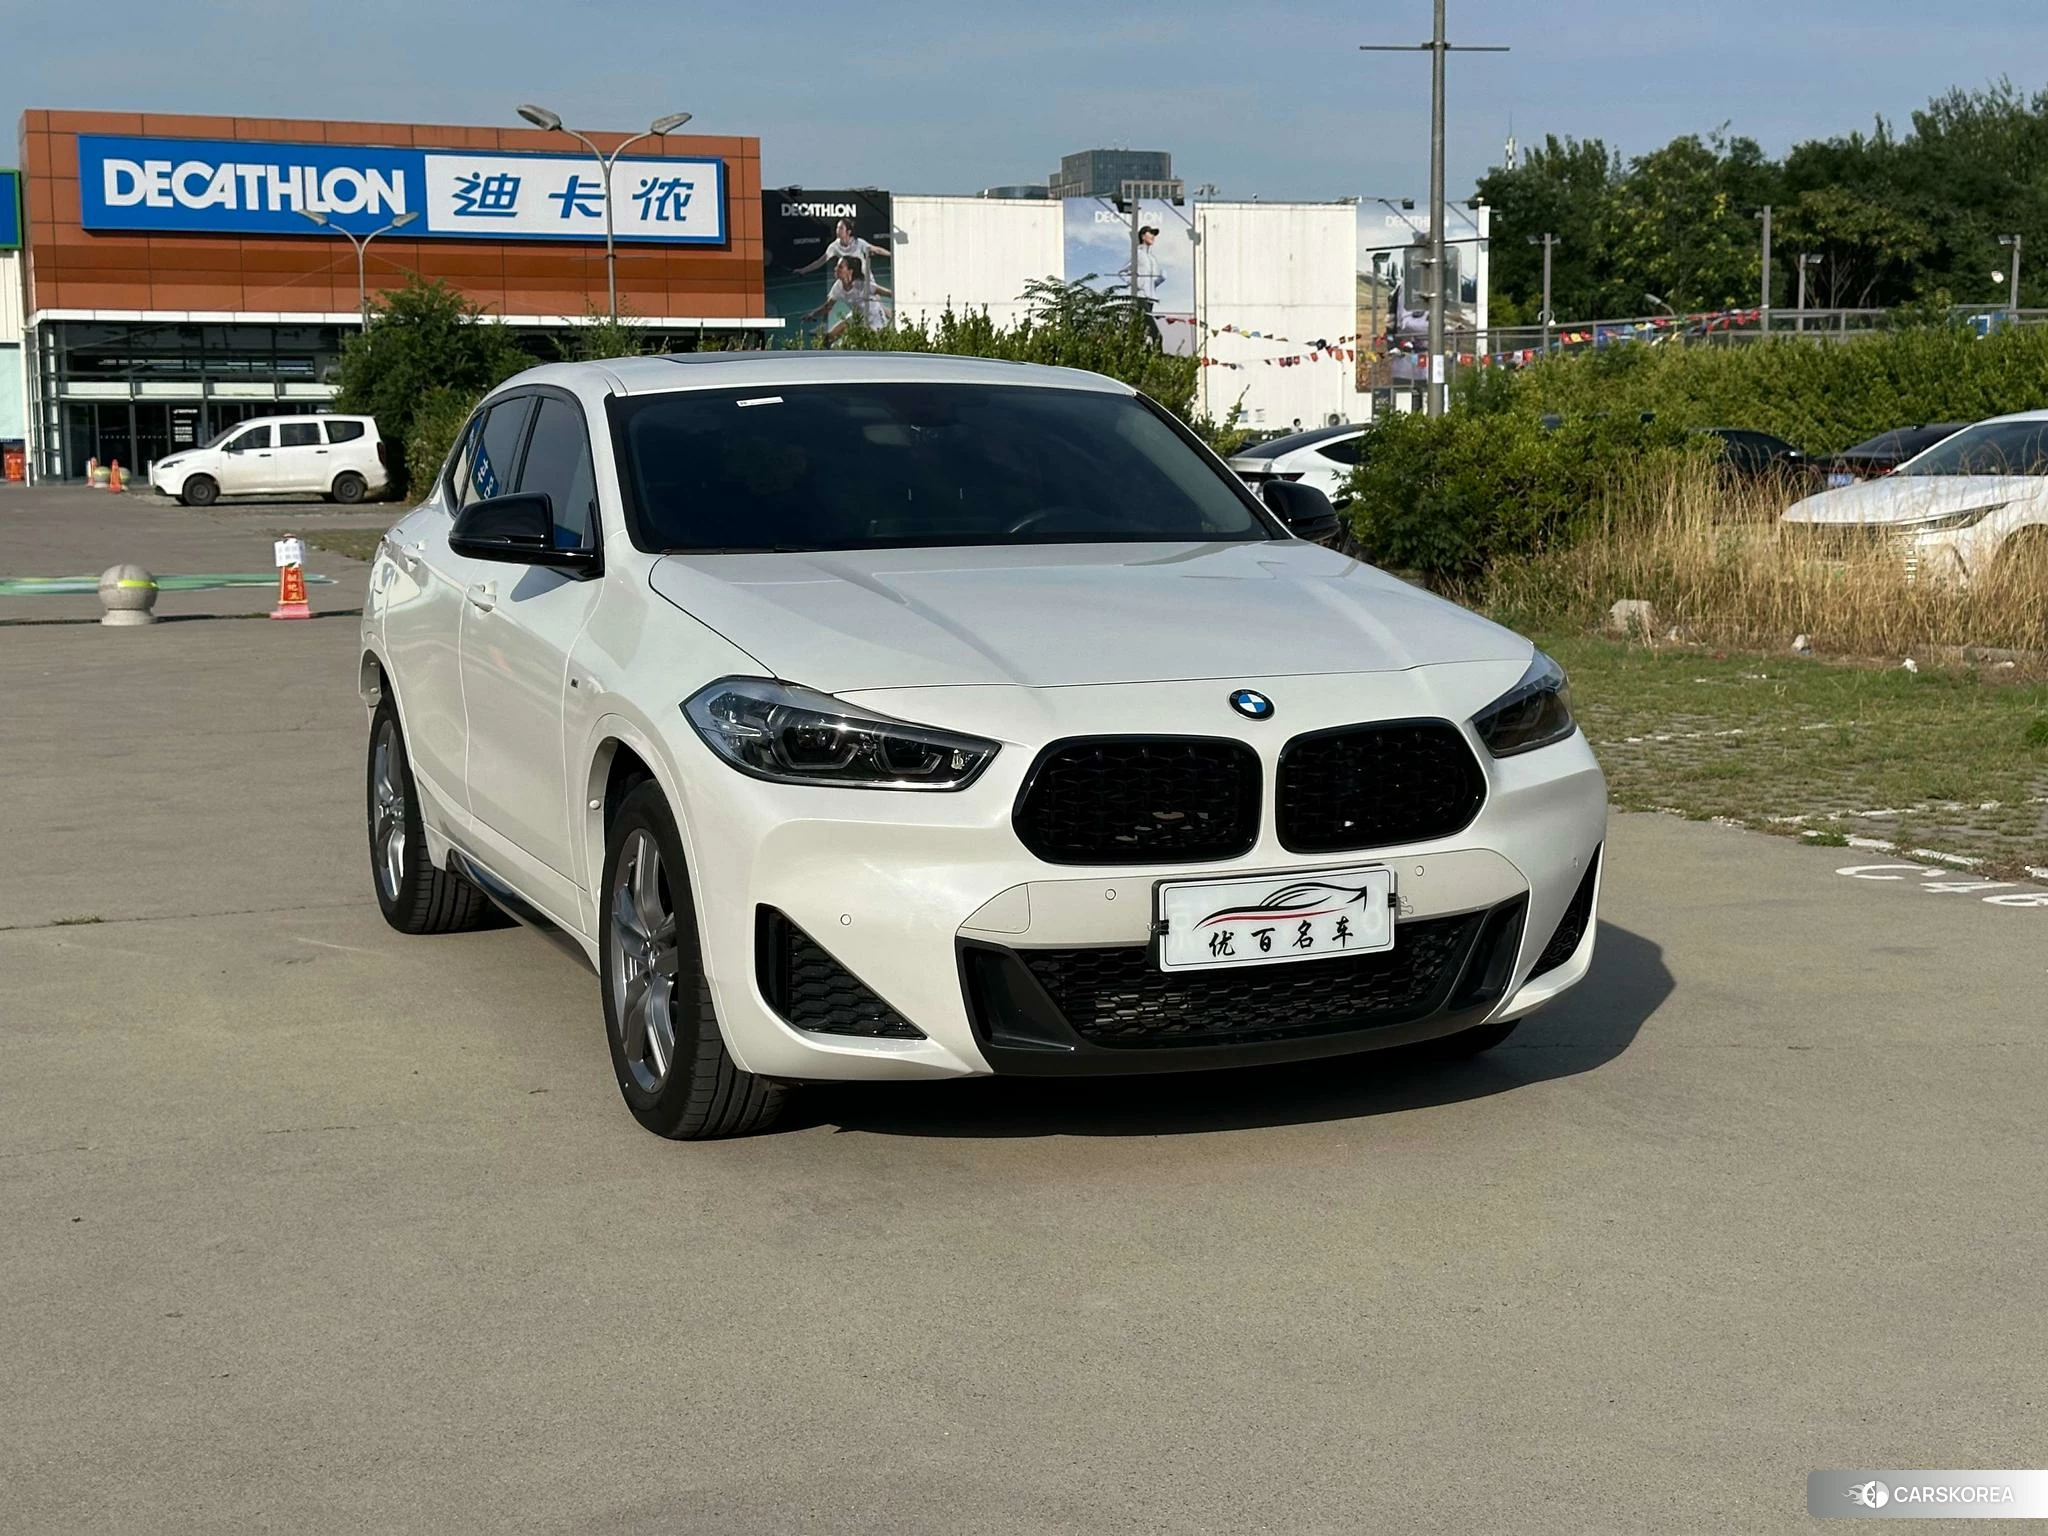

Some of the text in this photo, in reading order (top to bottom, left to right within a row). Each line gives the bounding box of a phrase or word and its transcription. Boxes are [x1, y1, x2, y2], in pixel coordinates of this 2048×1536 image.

[103, 159, 406, 215] DECATHLON
[451, 171, 694, 222] 迪卡侬
[781, 203, 857, 217] DECATHLON
[1208, 915, 1354, 958] 优百名车
